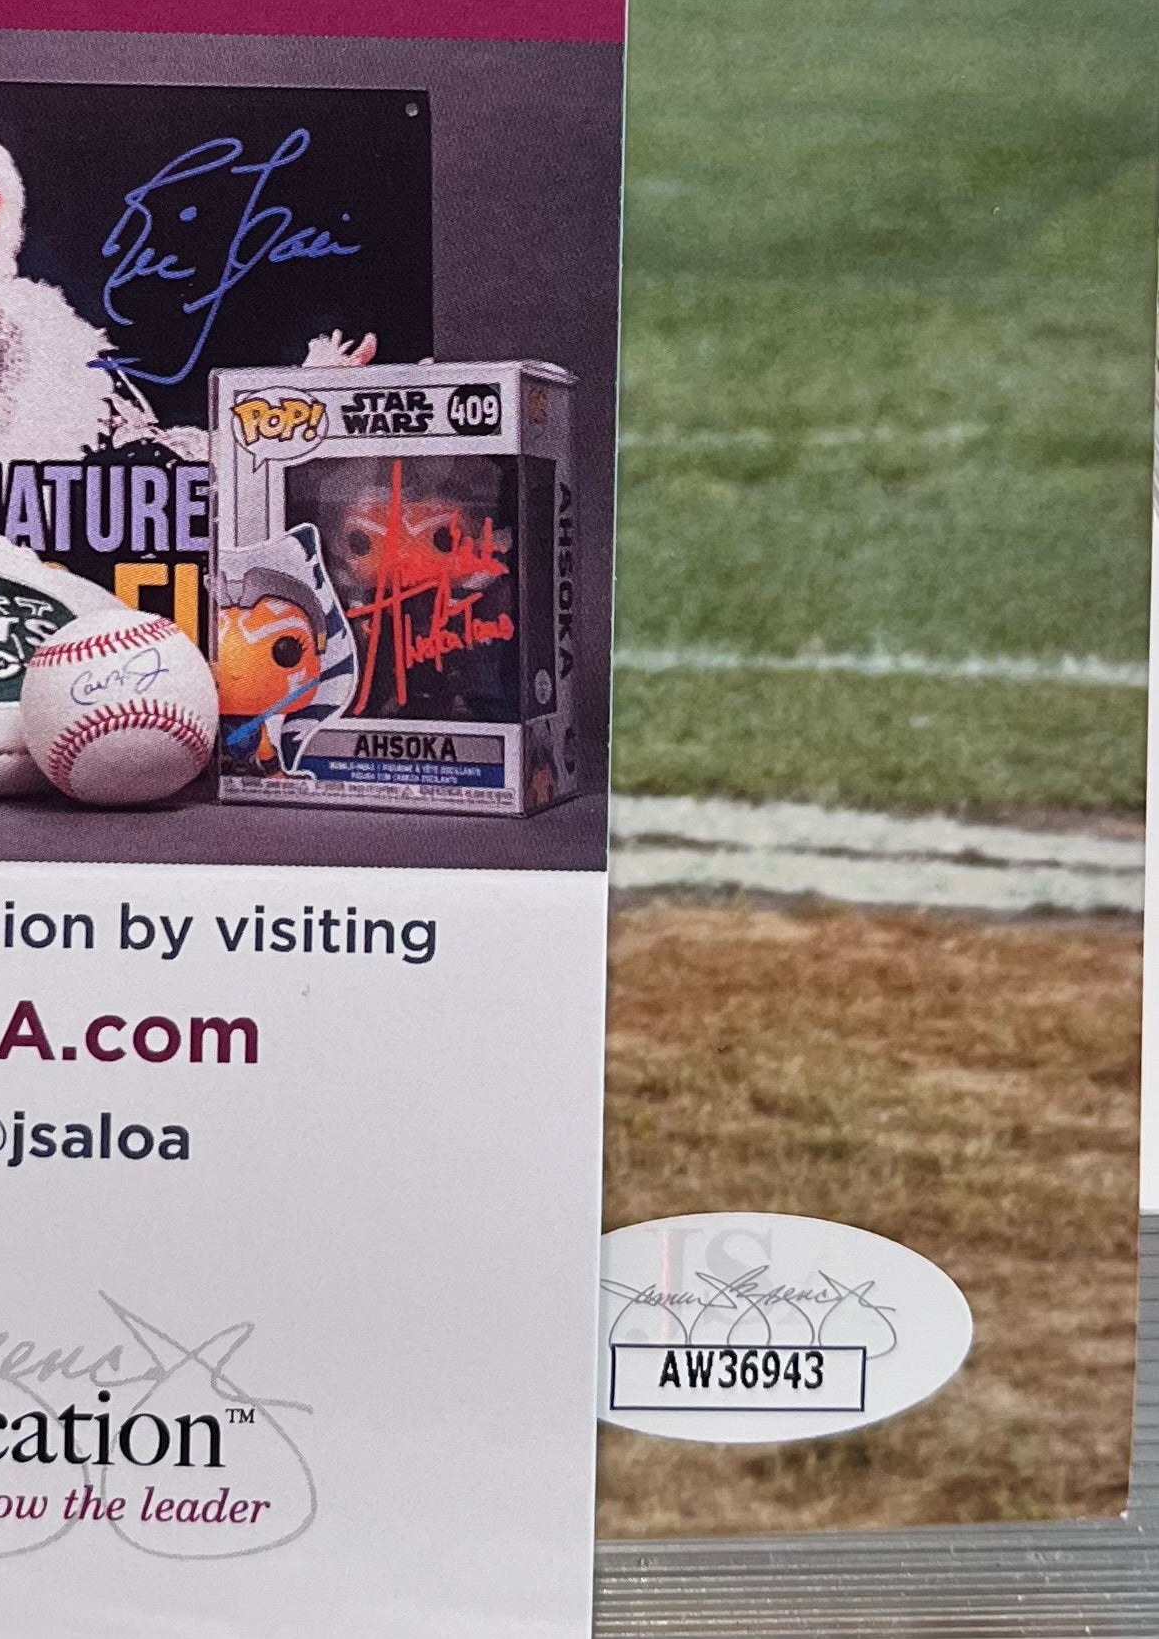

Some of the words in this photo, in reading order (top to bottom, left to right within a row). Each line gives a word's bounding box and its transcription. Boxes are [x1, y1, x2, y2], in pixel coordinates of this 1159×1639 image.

[342, 391, 434, 412] STAR
[450, 394, 499, 427] 409
[343, 412, 434, 434] WARS
[353, 733, 458, 762] AHSOKA
[120, 902, 194, 961] by
[214, 904, 437, 965] visiting
[658, 1349, 825, 1390] AW36943
[62, 1486, 125, 1523] the
[140, 1486, 271, 1526] leader
